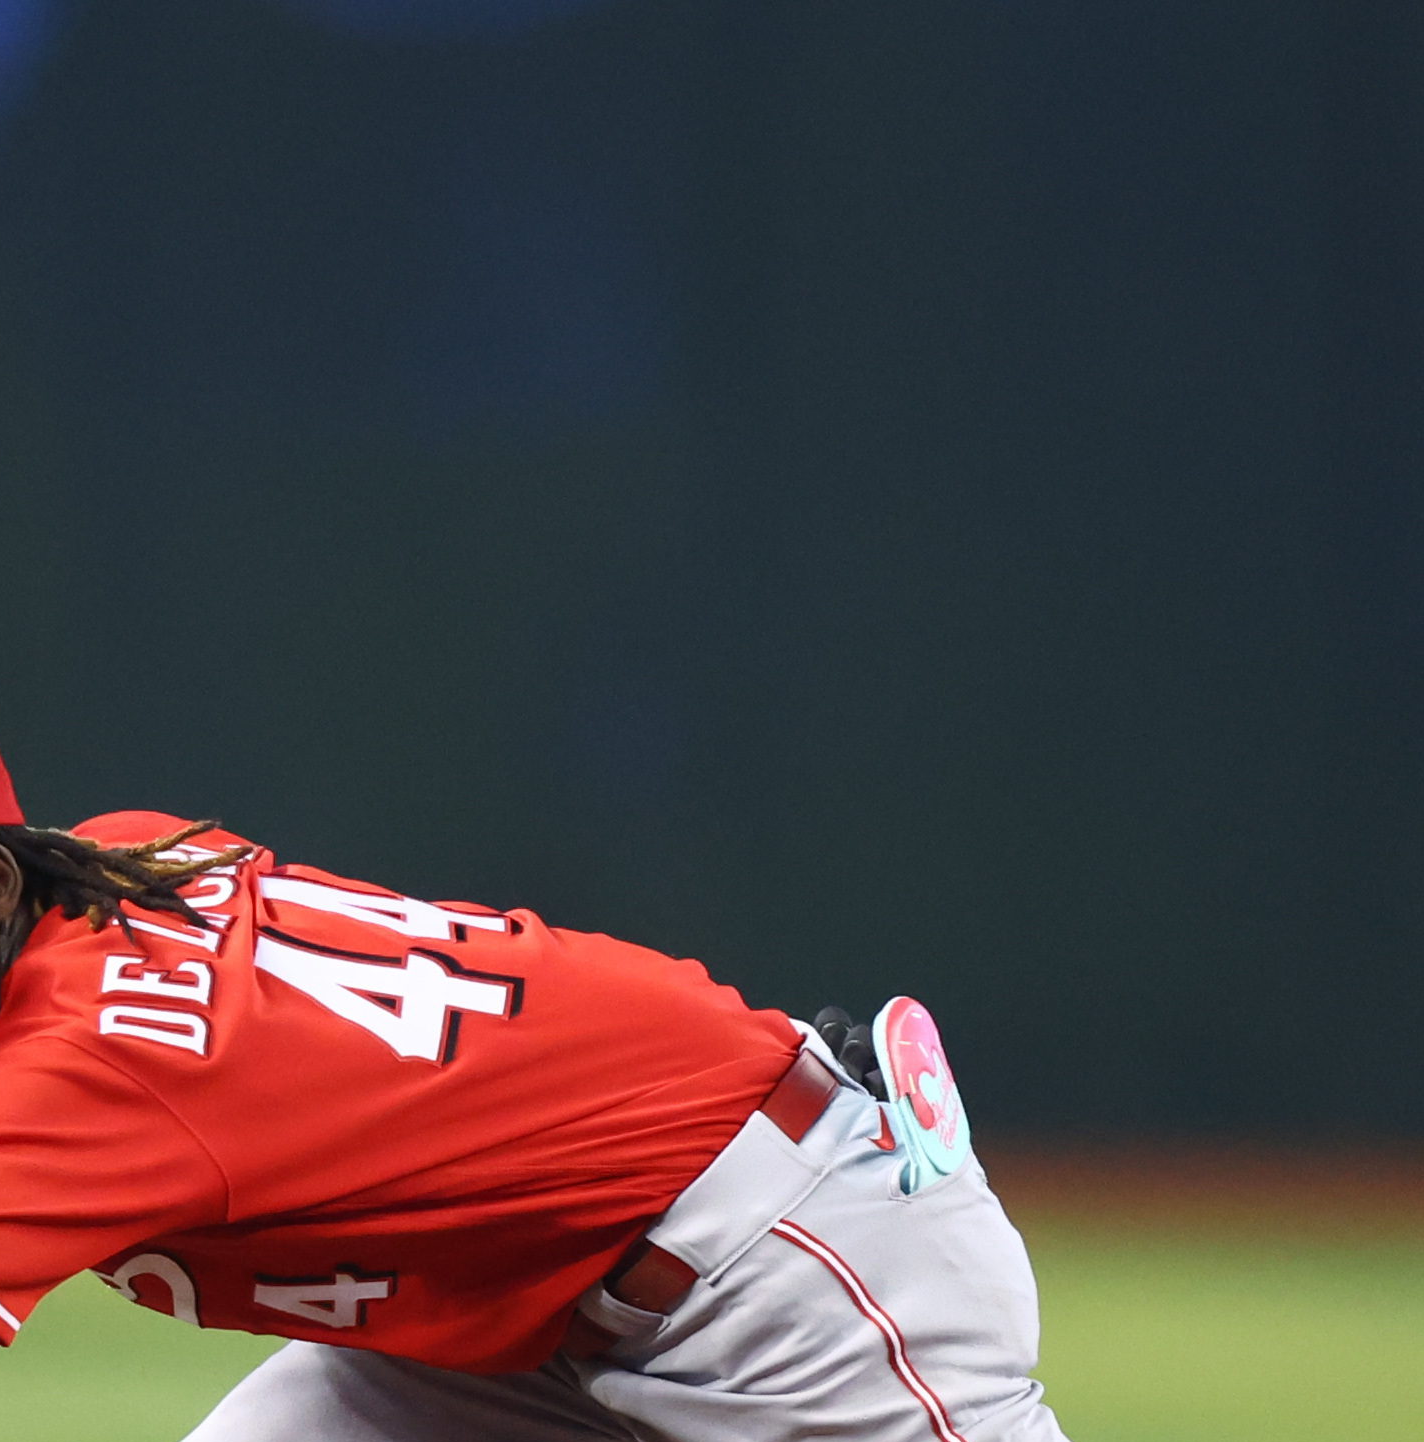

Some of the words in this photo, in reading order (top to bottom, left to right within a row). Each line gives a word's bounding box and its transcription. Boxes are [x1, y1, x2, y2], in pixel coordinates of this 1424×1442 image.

[98, 953, 214, 1058] DE
[253, 874, 521, 1067] 44
[253, 1268, 393, 1329] 4
